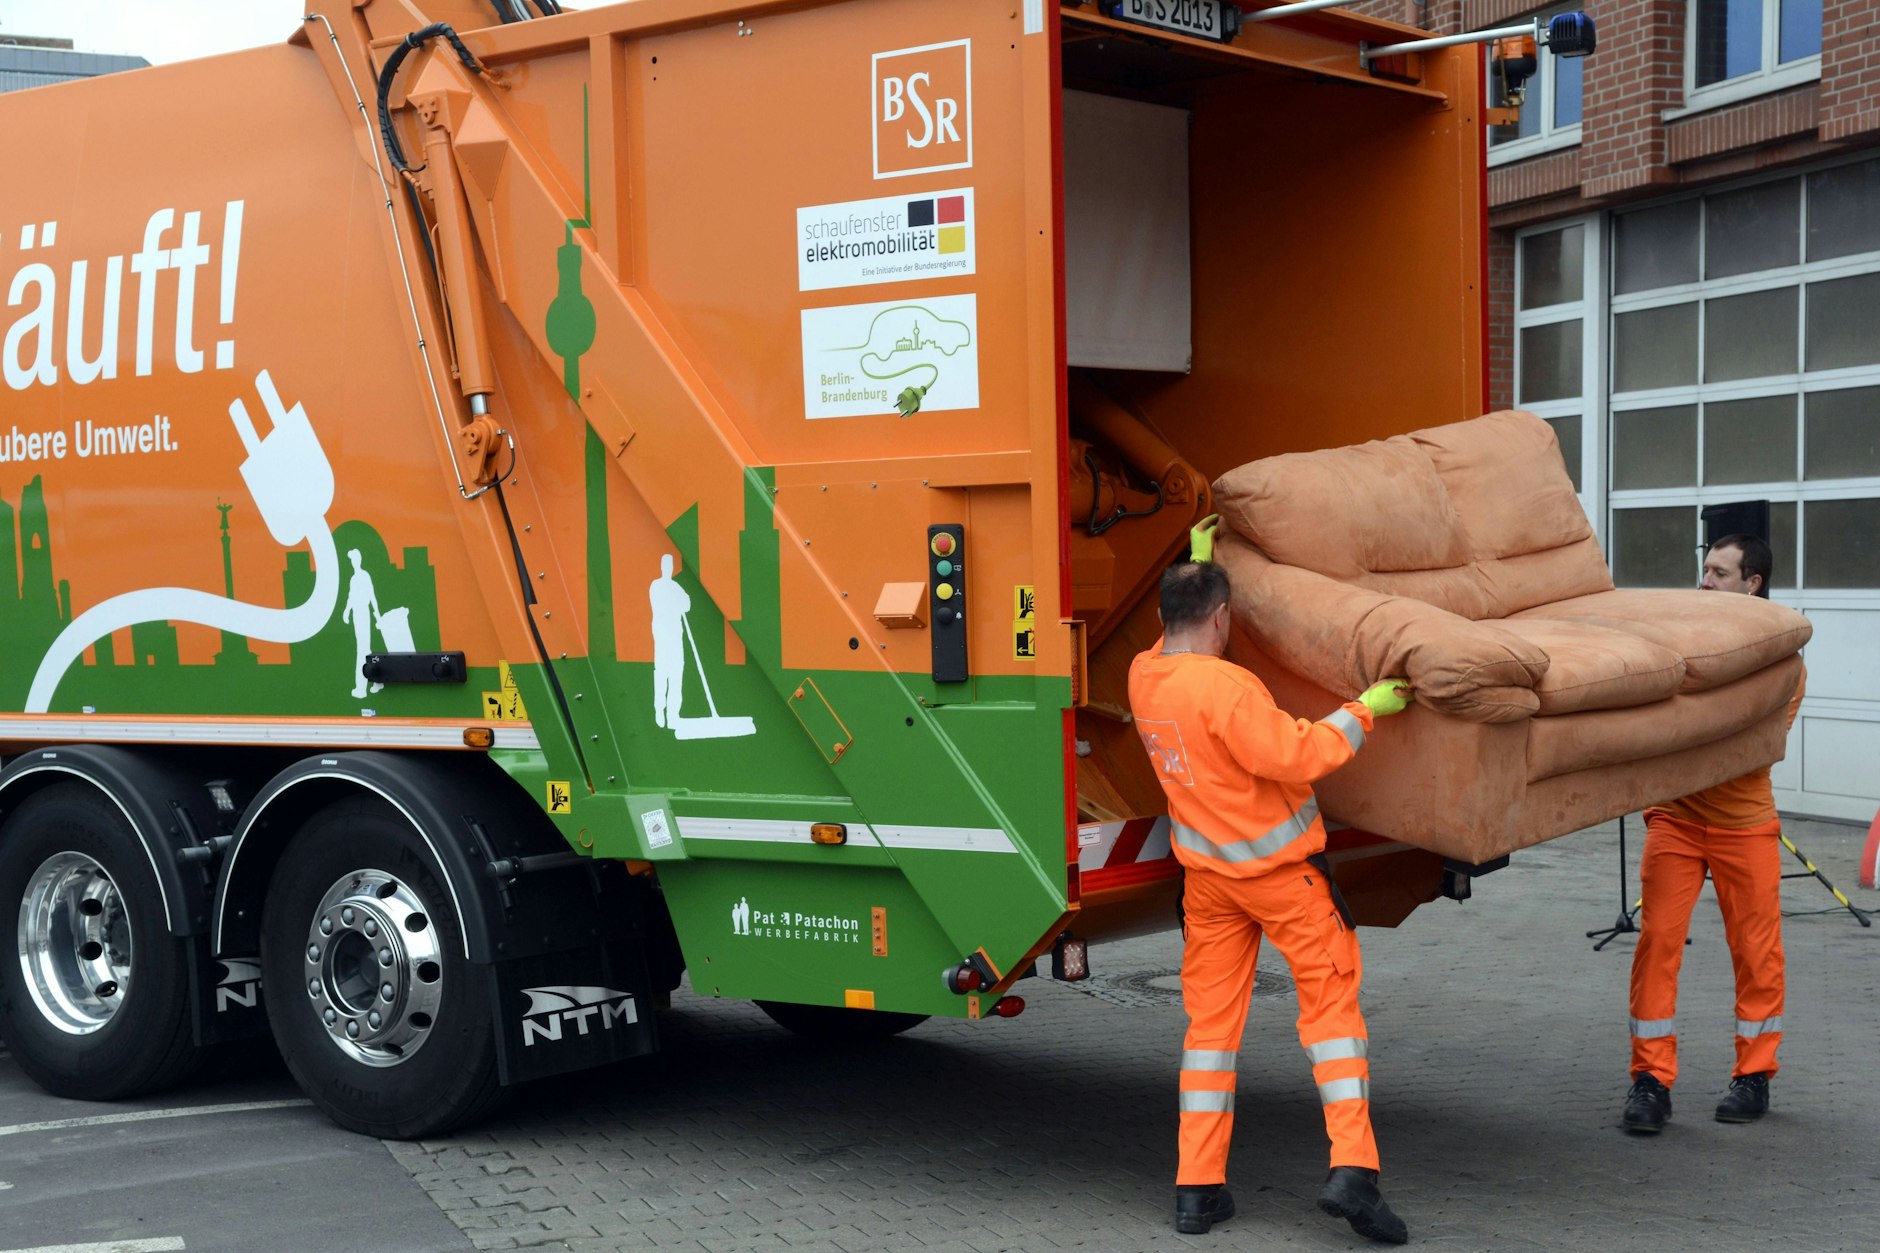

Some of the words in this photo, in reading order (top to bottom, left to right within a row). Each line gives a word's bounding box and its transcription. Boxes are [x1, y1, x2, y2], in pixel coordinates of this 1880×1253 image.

[883, 71, 961, 149] BSR
[805, 210, 902, 240] schaufenster
[806, 229, 935, 262] elektromobilität
[862, 268, 875, 276] Eine
[876, 265, 902, 275] Initiative
[903, 264, 913, 272] der
[914, 259, 967, 271] Bundesregierung
[0, 200, 244, 390] äuft!
[820, 372, 855, 386] Berlin-
[821, 388, 888, 403] Brandenburg
[0, 426, 67, 462] ubere
[75, 415, 178, 458] Umwelt.
[753, 910, 775, 925] Pat
[795, 913, 859, 930] Patachon
[754, 928, 859, 943] WERBEFABRIK
[216, 981, 262, 1012] N
[522, 998, 638, 1046] NTM
